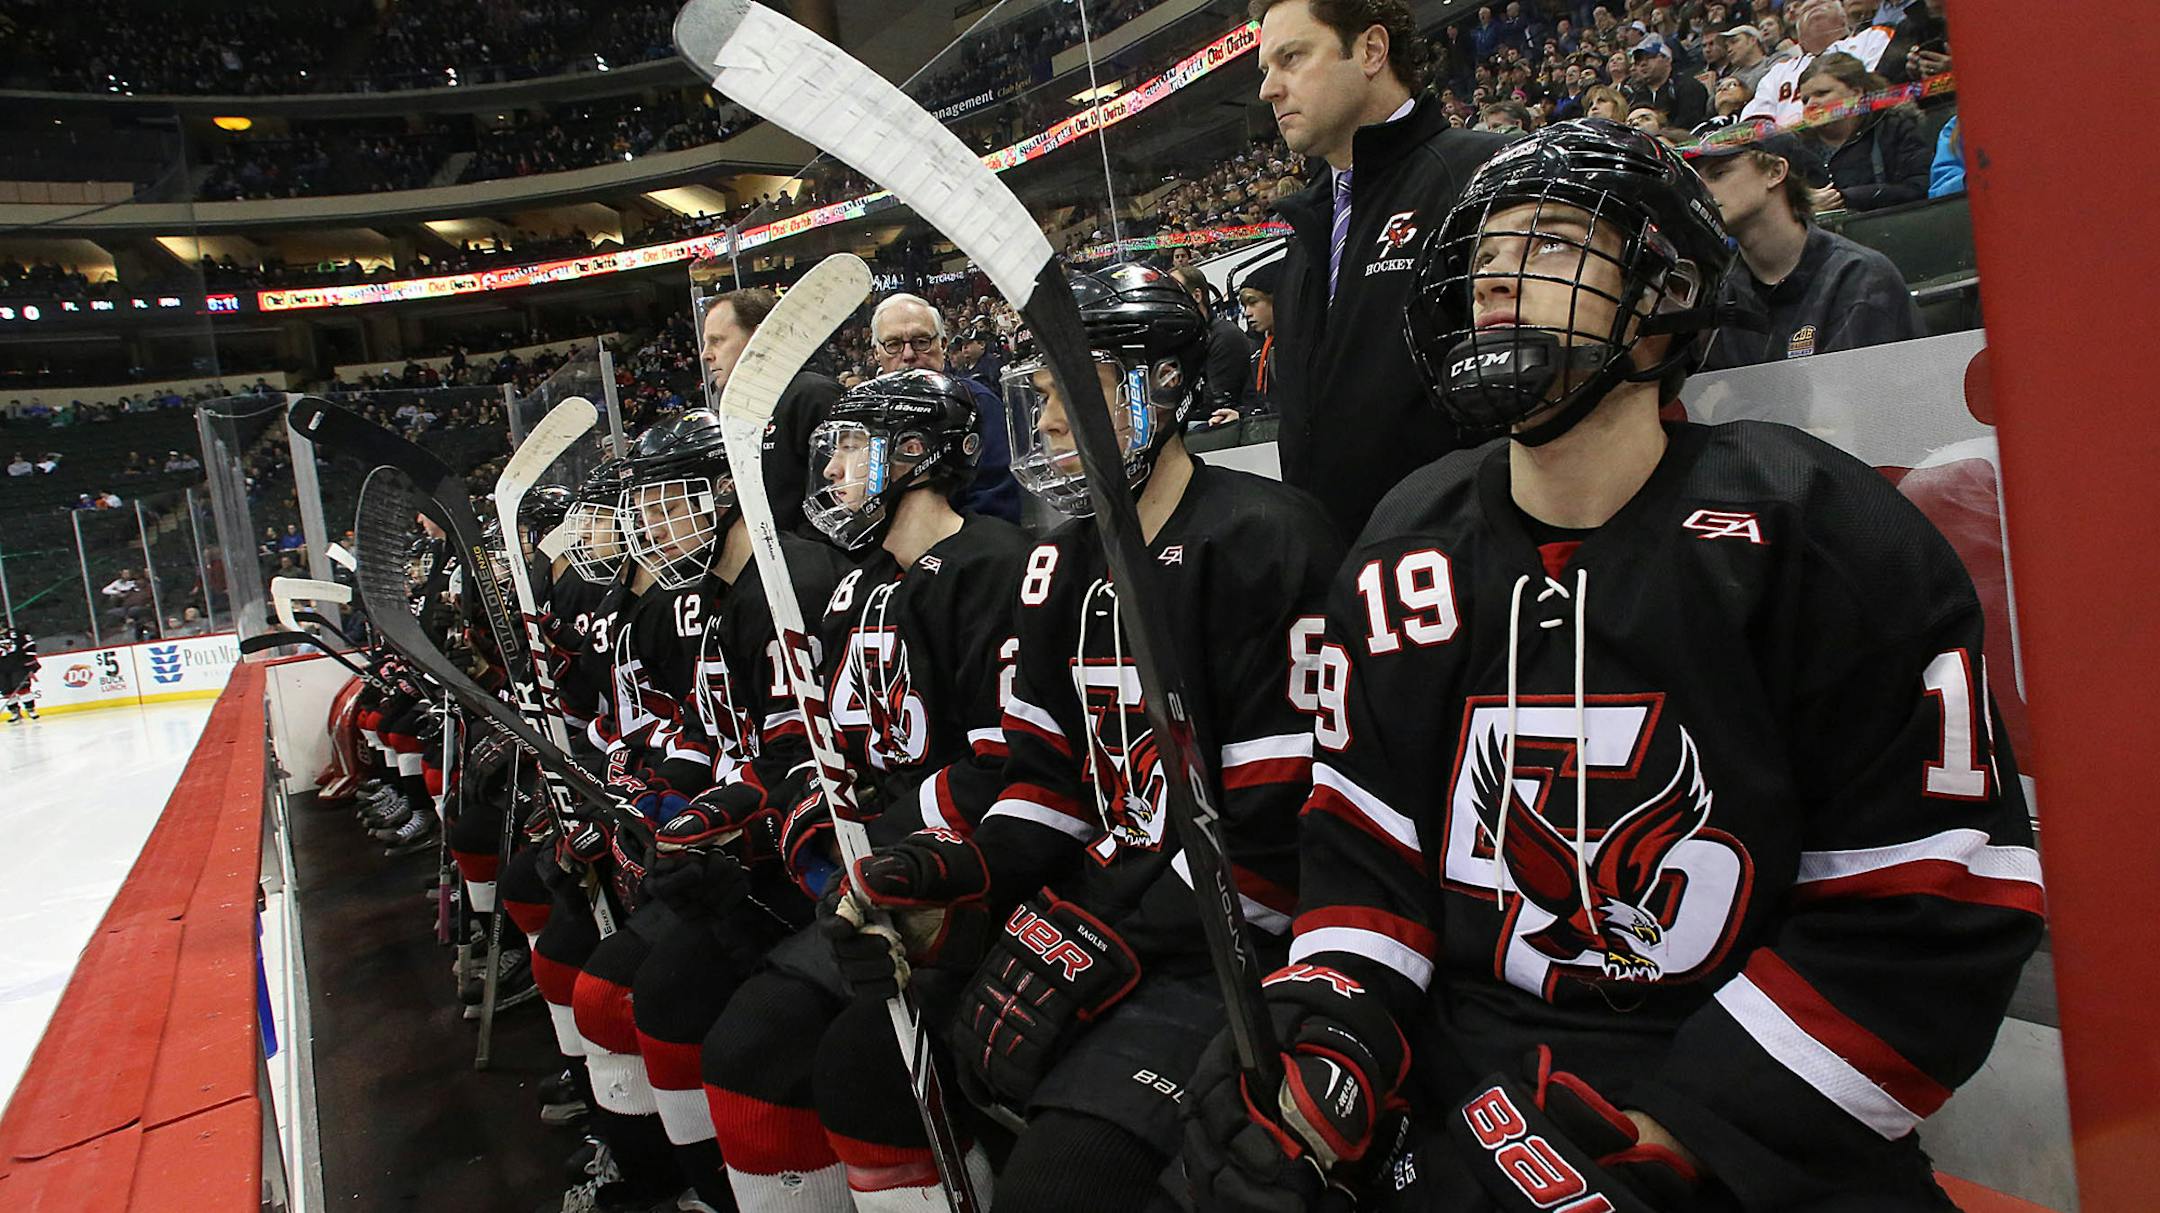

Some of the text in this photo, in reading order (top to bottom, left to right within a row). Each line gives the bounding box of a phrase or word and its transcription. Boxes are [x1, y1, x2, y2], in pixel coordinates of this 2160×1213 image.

[931, 88, 994, 120] anagement
[1364, 258, 1415, 277] HOCKEY
[1450, 350, 1512, 378] CCM
[894, 403, 932, 414] BAUER
[1128, 372, 1147, 445] BAUER
[868, 437, 881, 493] BAUER
[1020, 544, 1059, 606] 8
[674, 593, 702, 638] 12
[1356, 546, 1460, 657] 19
[95, 651, 120, 678] $5
[99, 676, 125, 686] BUCK
[781, 628, 863, 818] CCM
[1918, 646, 2002, 803] 1
[1076, 923, 1109, 952] EAGLES
[1461, 1085, 1617, 1213] BA
